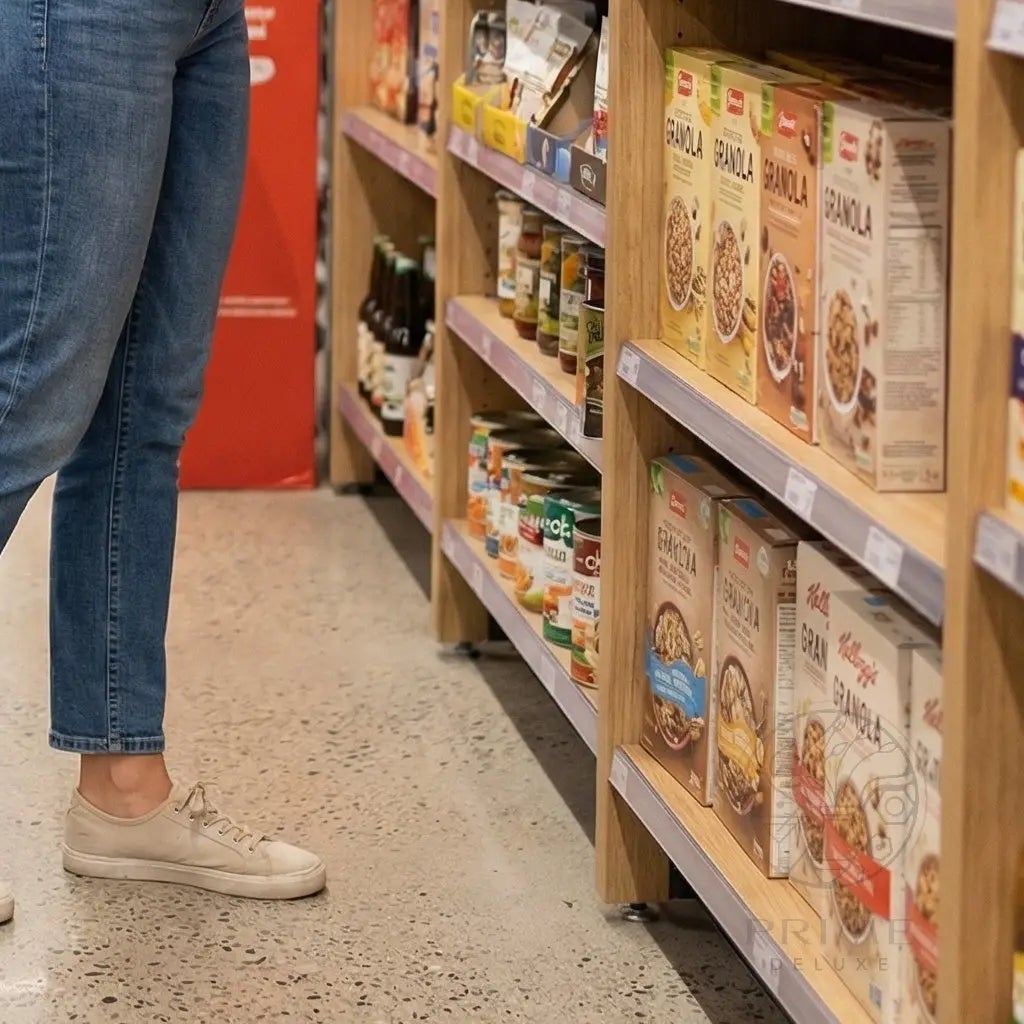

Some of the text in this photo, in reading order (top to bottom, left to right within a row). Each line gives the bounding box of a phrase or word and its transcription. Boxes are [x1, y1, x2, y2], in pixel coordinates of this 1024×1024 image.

[666, 117, 703, 160] GRANOLA
[714, 138, 754, 183] GRANOLA
[763, 158, 808, 208] GRANOLA
[824, 186, 872, 239] GRANOLA
[833, 675, 883, 751] GRANOLA
